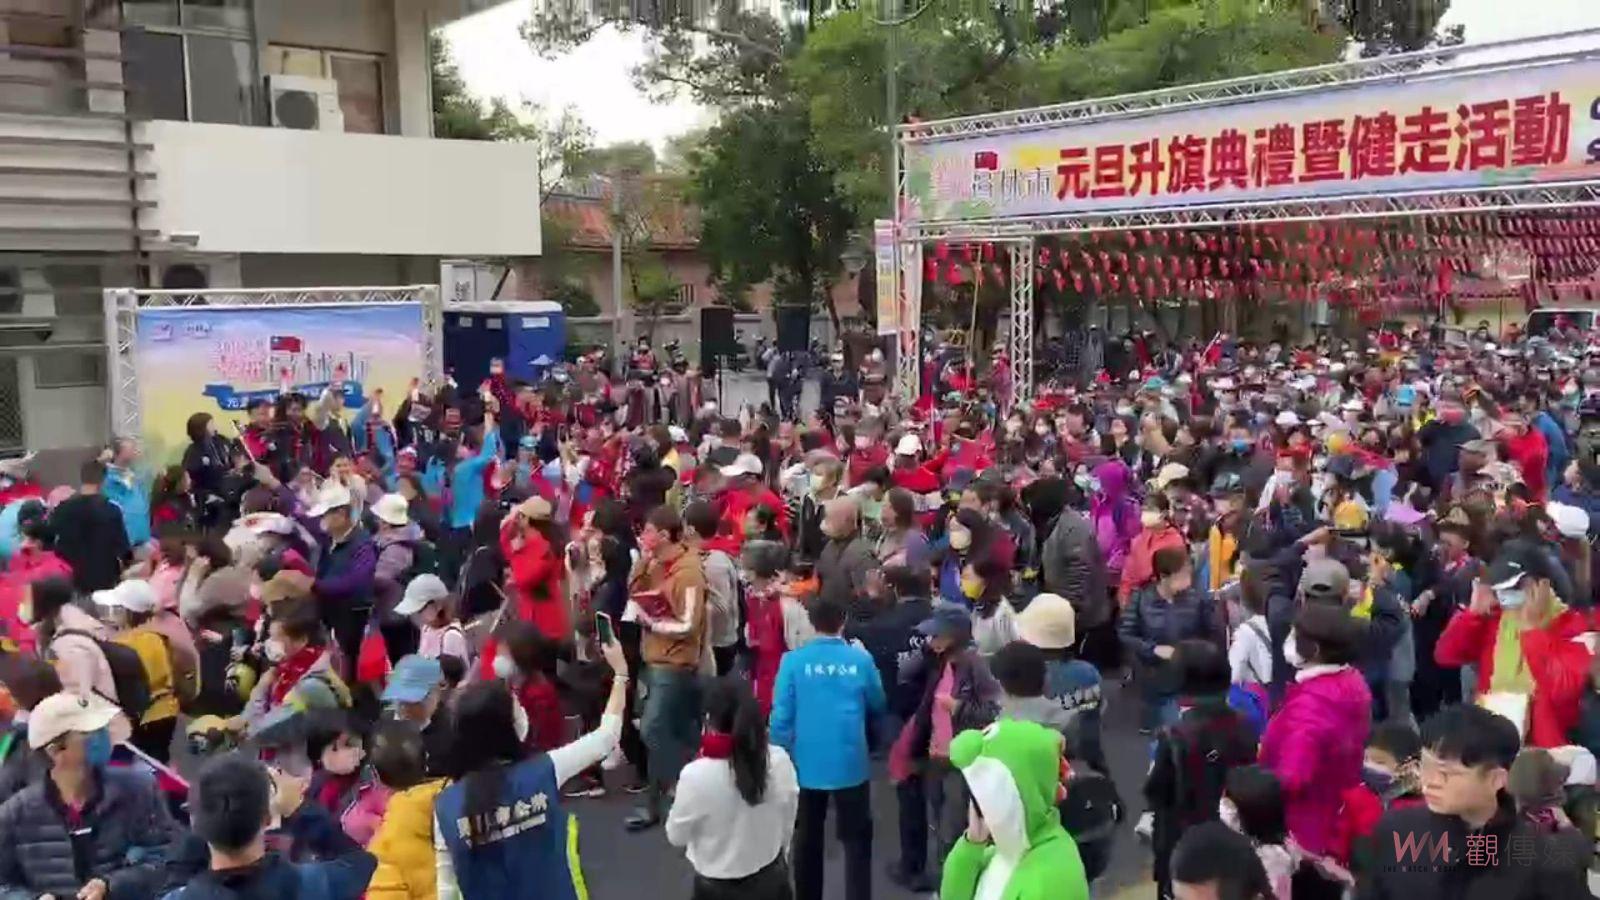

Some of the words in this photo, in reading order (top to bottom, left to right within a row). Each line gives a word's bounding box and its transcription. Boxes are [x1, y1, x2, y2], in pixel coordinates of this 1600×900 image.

[1056, 91, 1571, 200] 元旦升旗典禮暨健走活動
